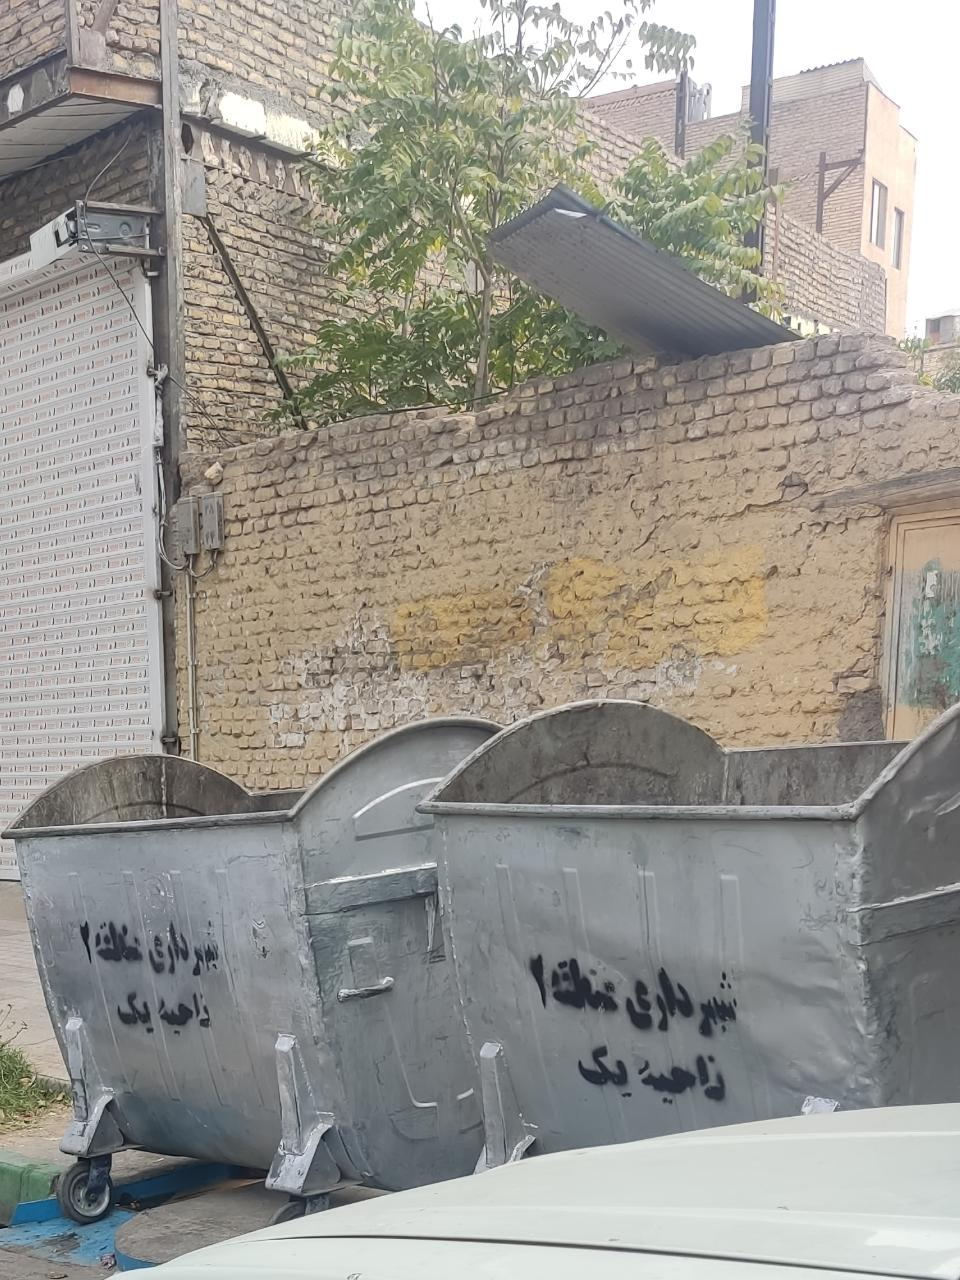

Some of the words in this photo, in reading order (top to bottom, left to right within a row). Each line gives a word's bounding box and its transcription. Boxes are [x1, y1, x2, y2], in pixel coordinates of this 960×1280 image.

[117, 992, 155, 1034] یک
[626, 966, 738, 1038] شهرداری
[578, 1045, 633, 1098] یک
